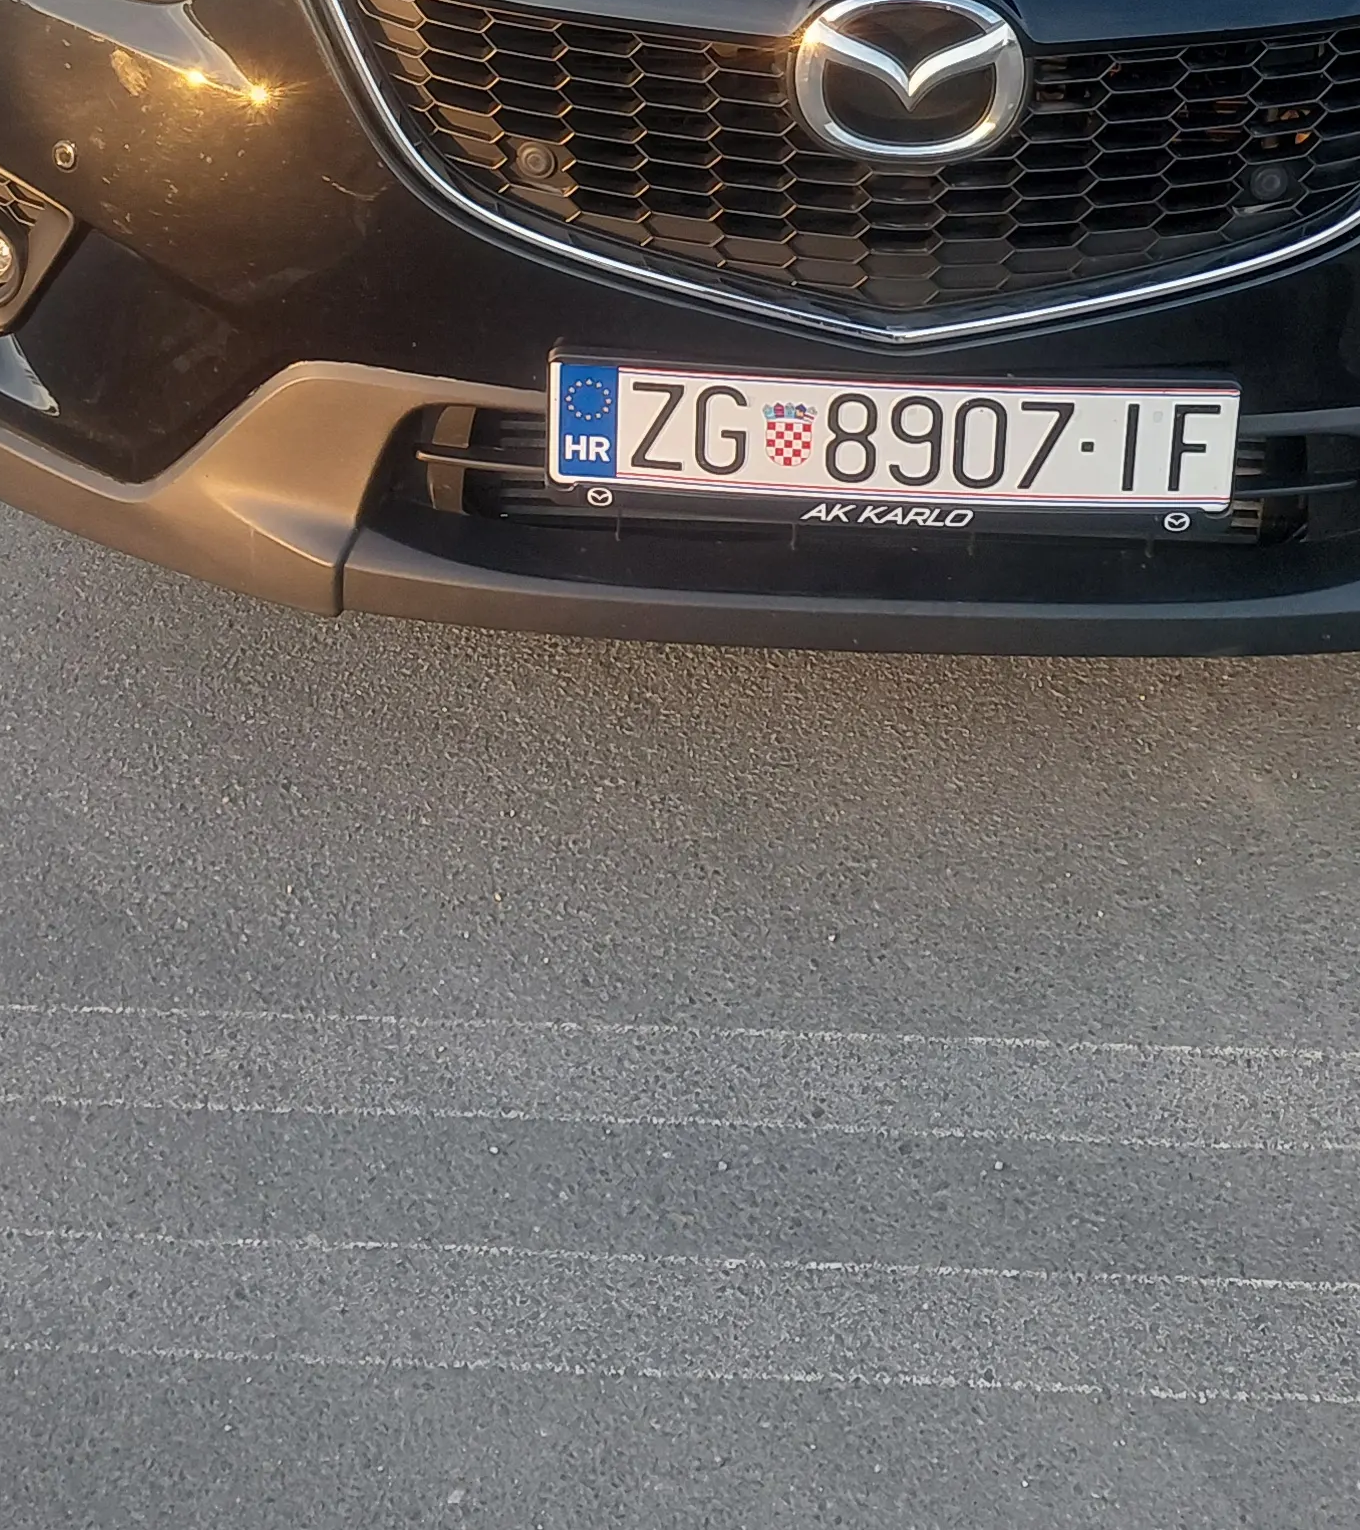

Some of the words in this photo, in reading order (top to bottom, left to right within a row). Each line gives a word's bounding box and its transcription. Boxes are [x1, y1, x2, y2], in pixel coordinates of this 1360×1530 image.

[630, 381, 748, 475] ZG
[564, 434, 611, 463] HR
[800, 502, 853, 524] AK
[856, 504, 975, 529] KARLO
